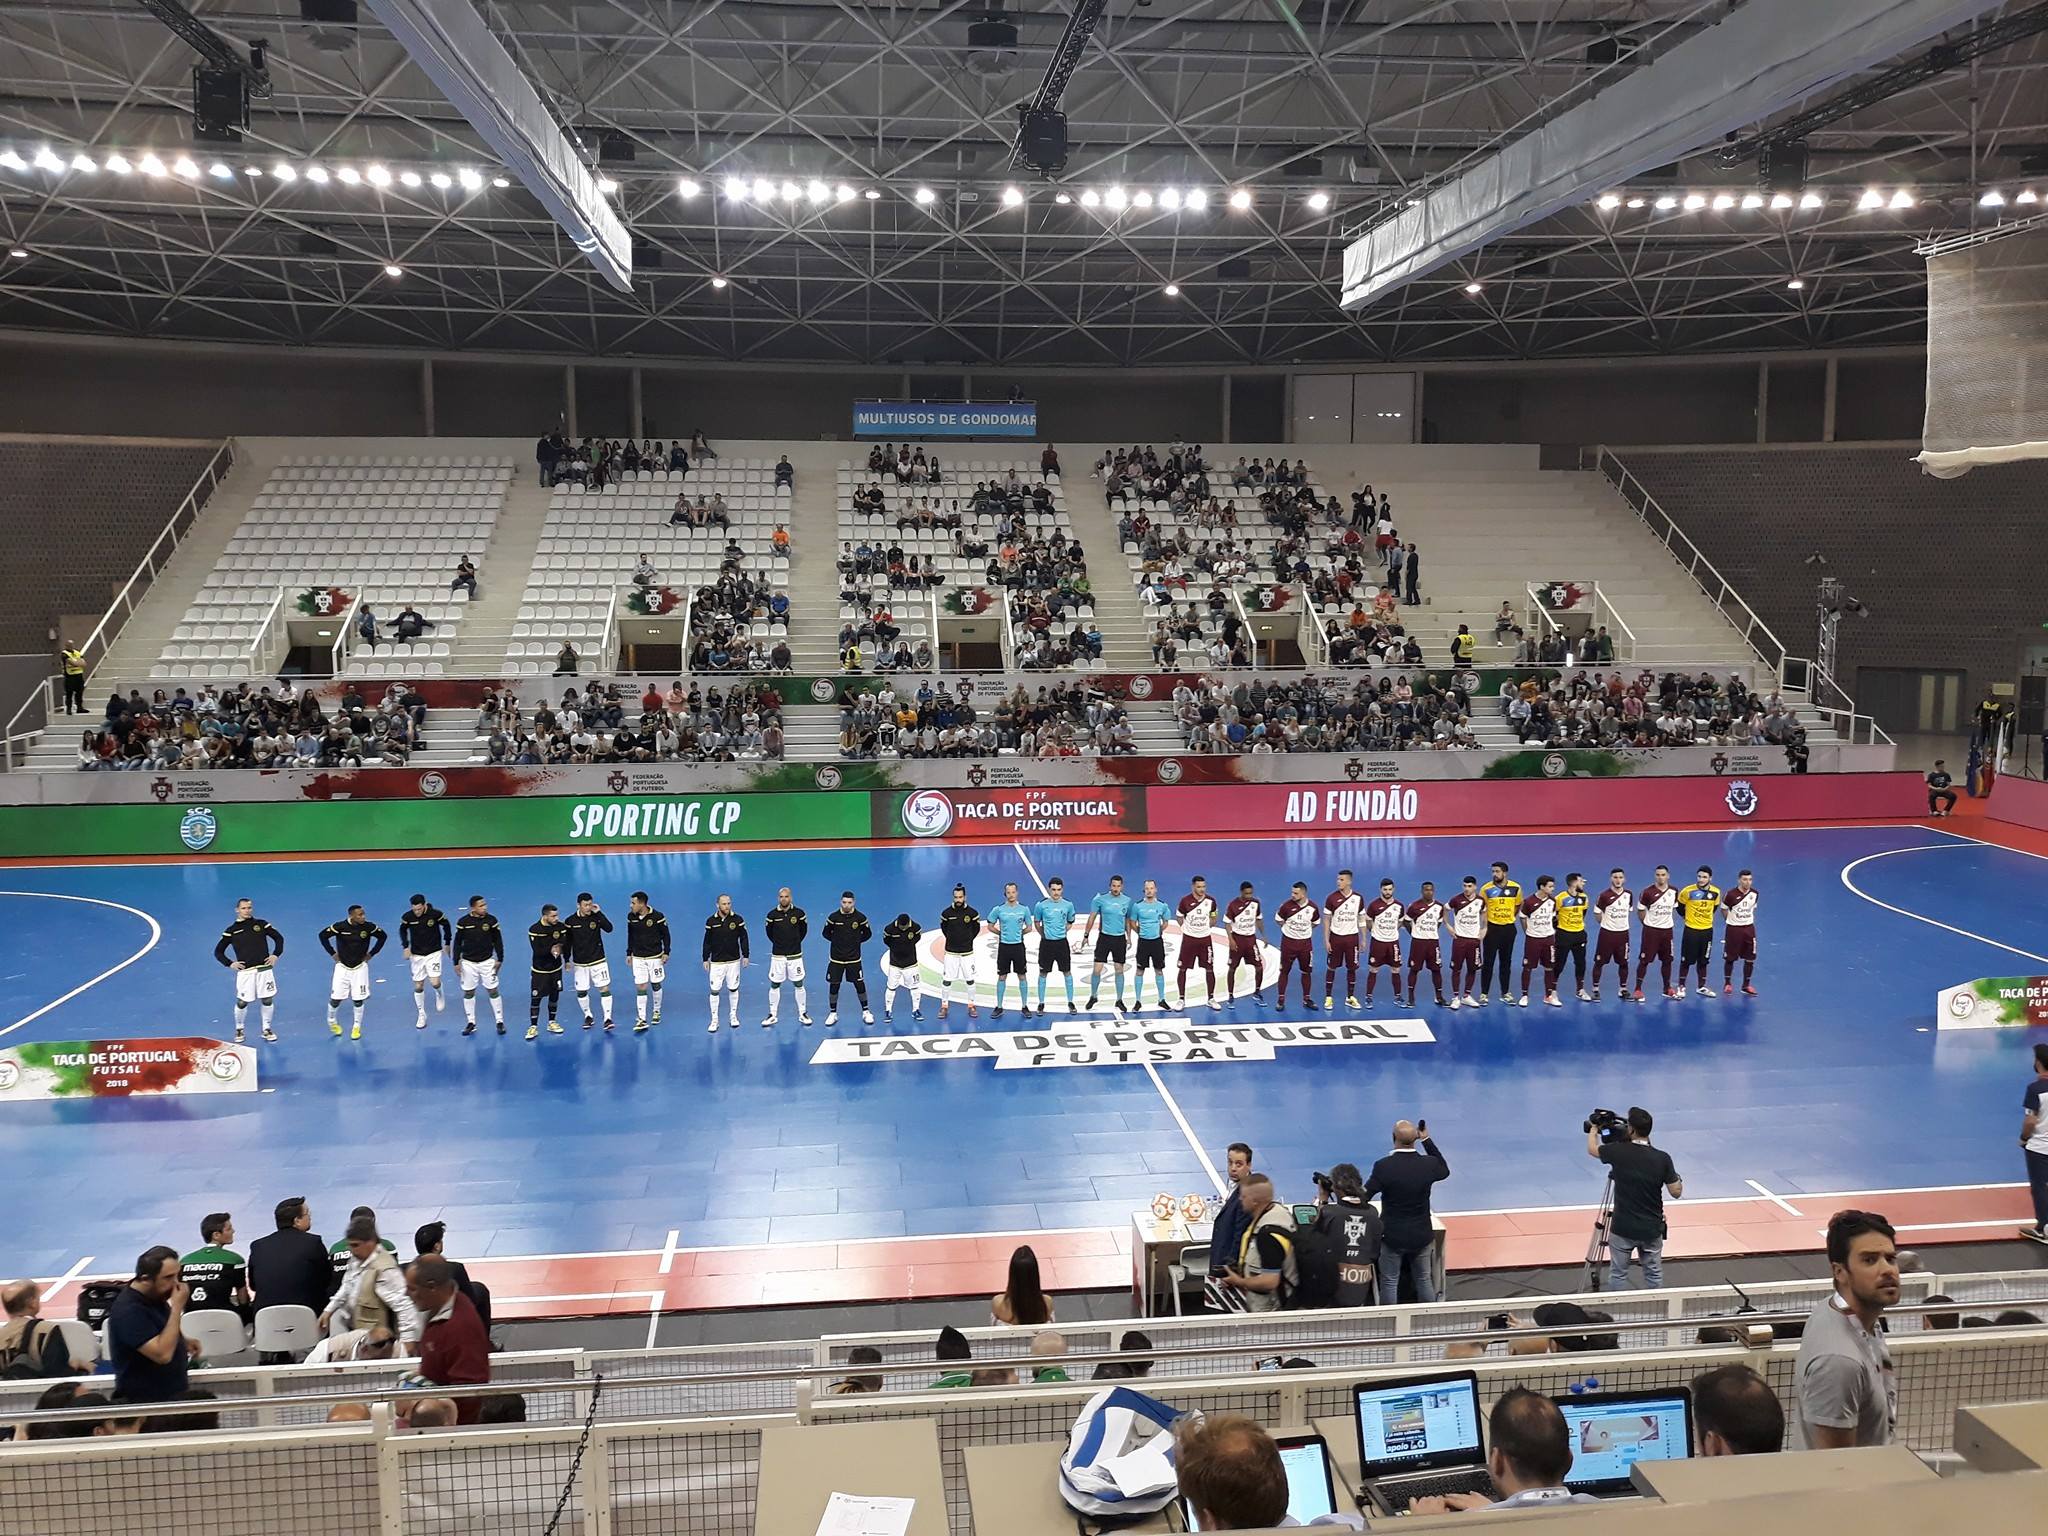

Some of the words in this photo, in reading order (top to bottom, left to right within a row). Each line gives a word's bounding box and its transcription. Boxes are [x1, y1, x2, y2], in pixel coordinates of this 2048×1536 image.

[858, 412, 935, 425] MULTIUSOS
[939, 413, 957, 425] DE
[632, 772, 664, 780] FEDERAÇÃO
[1284, 791, 1318, 823] AD
[1325, 784, 1418, 822] FUNDÃO
[186, 806, 212, 816] SCP
[956, 803, 998, 820] TAÇA
[1002, 802, 1025, 817] DE
[1029, 801, 1118, 817] PORTUGAL
[569, 802, 701, 838] SPORTING
[708, 801, 741, 835] CP
[1014, 819, 1061, 831] FUTSAL
[1998, 988, 2025, 999] TAÇA
[2026, 987, 2041, 998] DE
[2028, 998, 2048, 1007] FUT
[847, 1036, 995, 1056] TAÇA
[1012, 1032, 1087, 1051] DE
[1103, 1023, 1409, 1047] PORTUGAL
[51, 1053, 86, 1067] TAÇA
[88, 1052, 107, 1065] DE
[109, 1050, 180, 1064] PORTUGAL
[1031, 1046, 1248, 1066] FUTSAL
[92, 1065, 141, 1075] FUTSAL
[105, 1079, 129, 1088] 2018
[182, 1263, 224, 1272] macron
